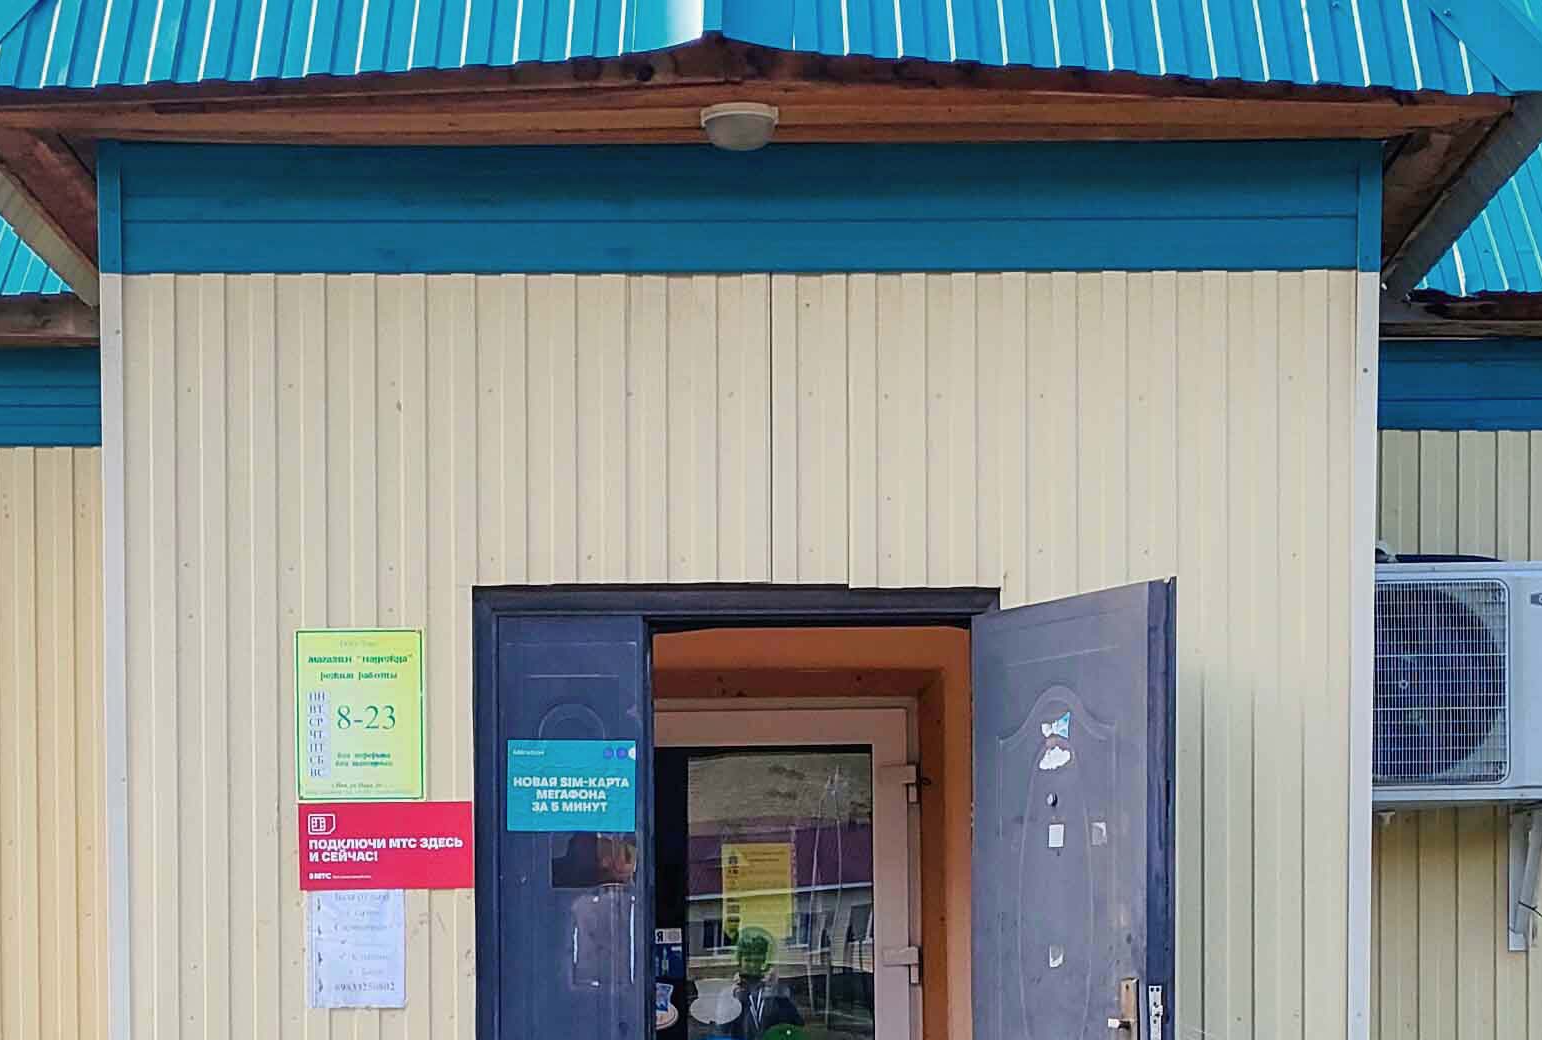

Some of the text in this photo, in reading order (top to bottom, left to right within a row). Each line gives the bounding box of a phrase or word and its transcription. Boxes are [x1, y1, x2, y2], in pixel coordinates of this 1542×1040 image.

[337, 705, 395, 729] 8-23
[513, 777, 629, 788] НОВАЯ SIM-КАРТА
[536, 789, 606, 800] МЕГАФОНА
[532, 801, 608, 812] ЗА 5 МИНУТ
[309, 837, 463, 850] ПОДКЛЮЧИ МТС ЗДЕСЬ
[309, 849, 378, 862] И СЕЙЧАС!
